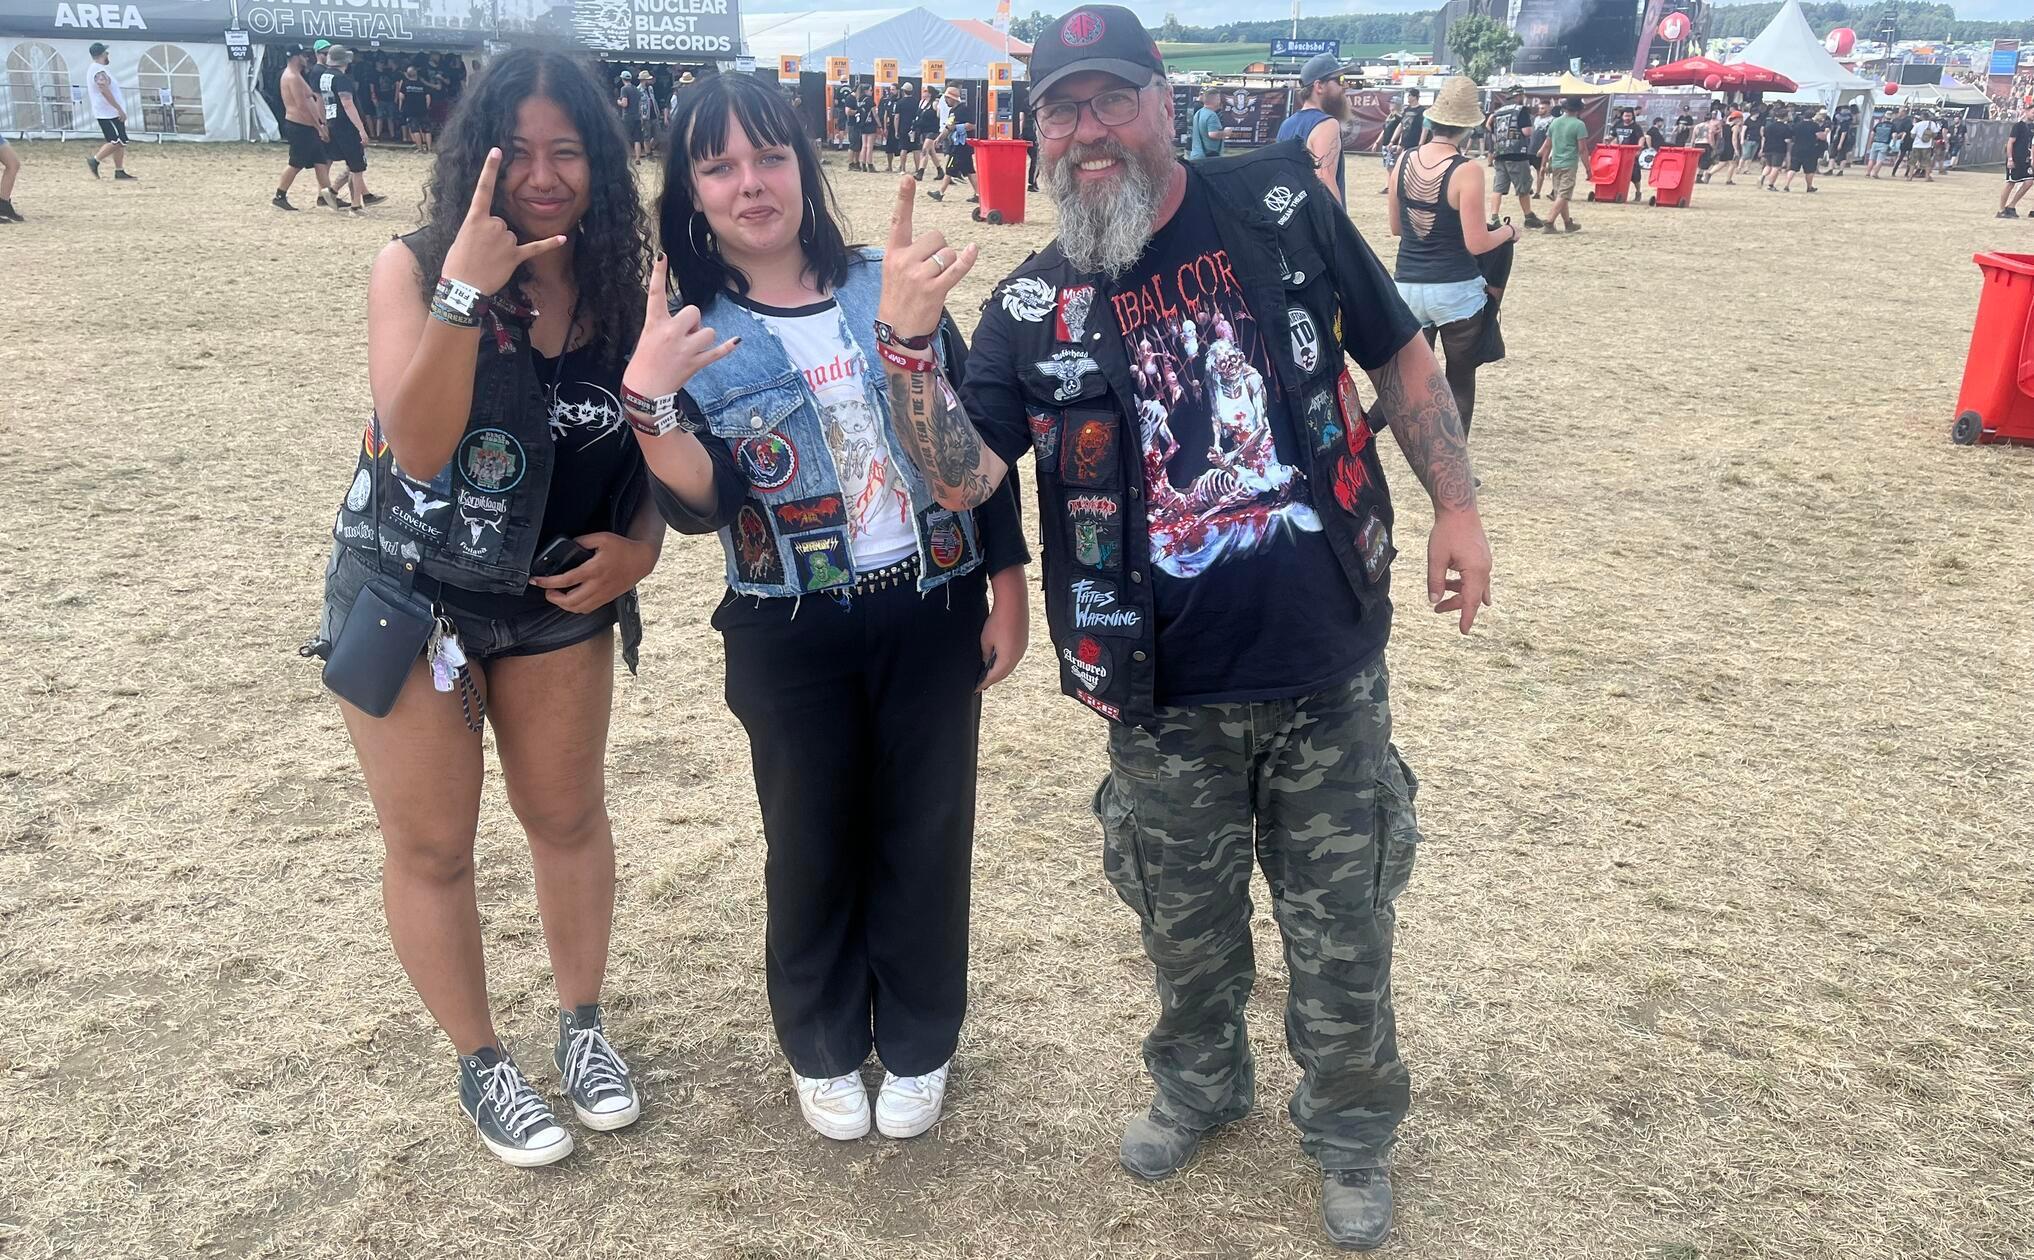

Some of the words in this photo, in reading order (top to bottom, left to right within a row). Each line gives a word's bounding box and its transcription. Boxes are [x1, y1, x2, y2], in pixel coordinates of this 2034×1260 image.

[55, 2, 147, 30] AREA
[633, 0, 728, 14] NUCLEAR
[248, 7, 295, 34] OF
[302, 10, 412, 40] METAL
[634, 15, 698, 32] BLAST
[636, 34, 732, 51] RECORDS
[1347, 95, 1380, 107] AREA
[1277, 207, 1294, 226] DREAM
[1177, 249, 1243, 315] COR
[454, 288, 470, 301] FRI
[887, 353, 907, 366] EMP
[1063, 647, 1107, 678] Armored
[1070, 664, 1100, 688] Saint
